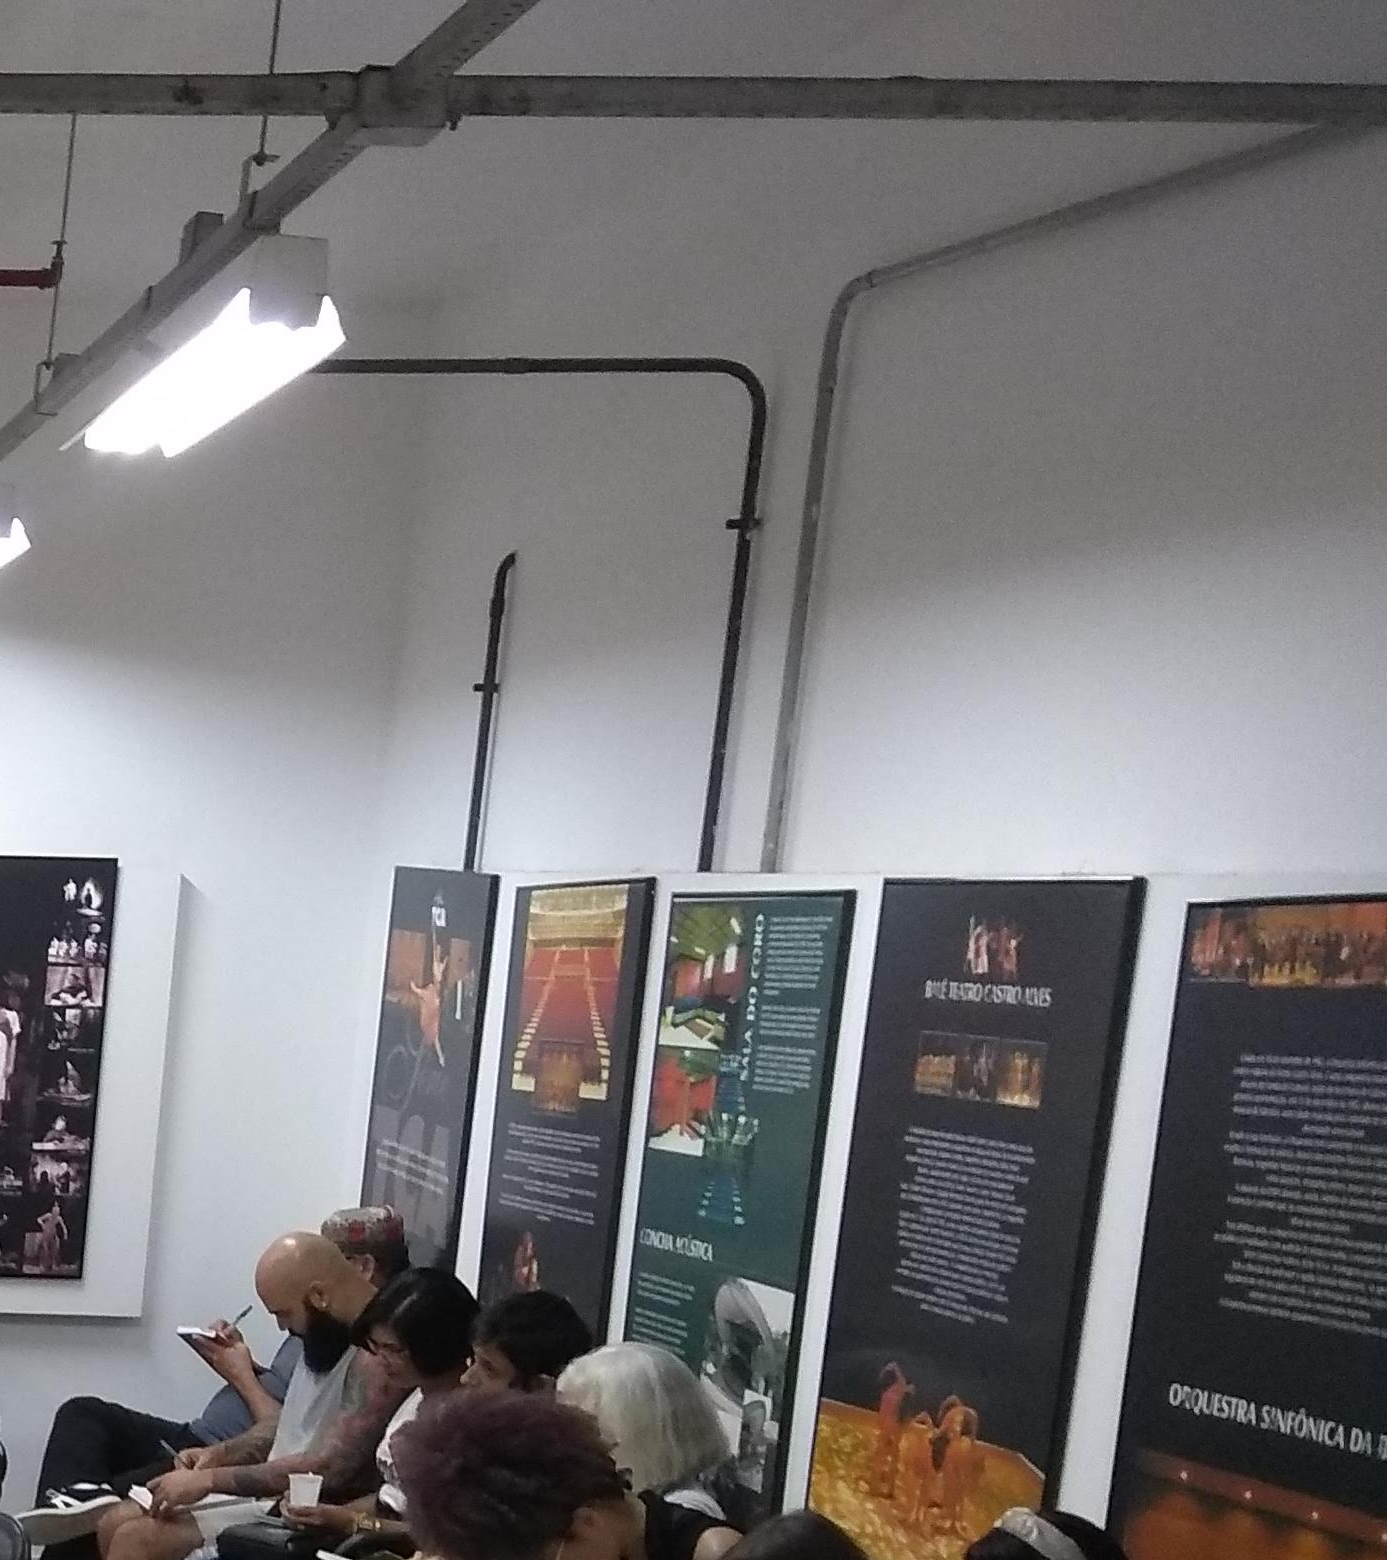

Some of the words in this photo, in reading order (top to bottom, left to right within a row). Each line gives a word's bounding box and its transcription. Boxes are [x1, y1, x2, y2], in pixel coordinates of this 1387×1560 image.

[1168, 1382, 1256, 1427] ORQUESTRA
[1260, 1404, 1345, 1449] SINFÔNICA
[1349, 1426, 1372, 1456] DA
